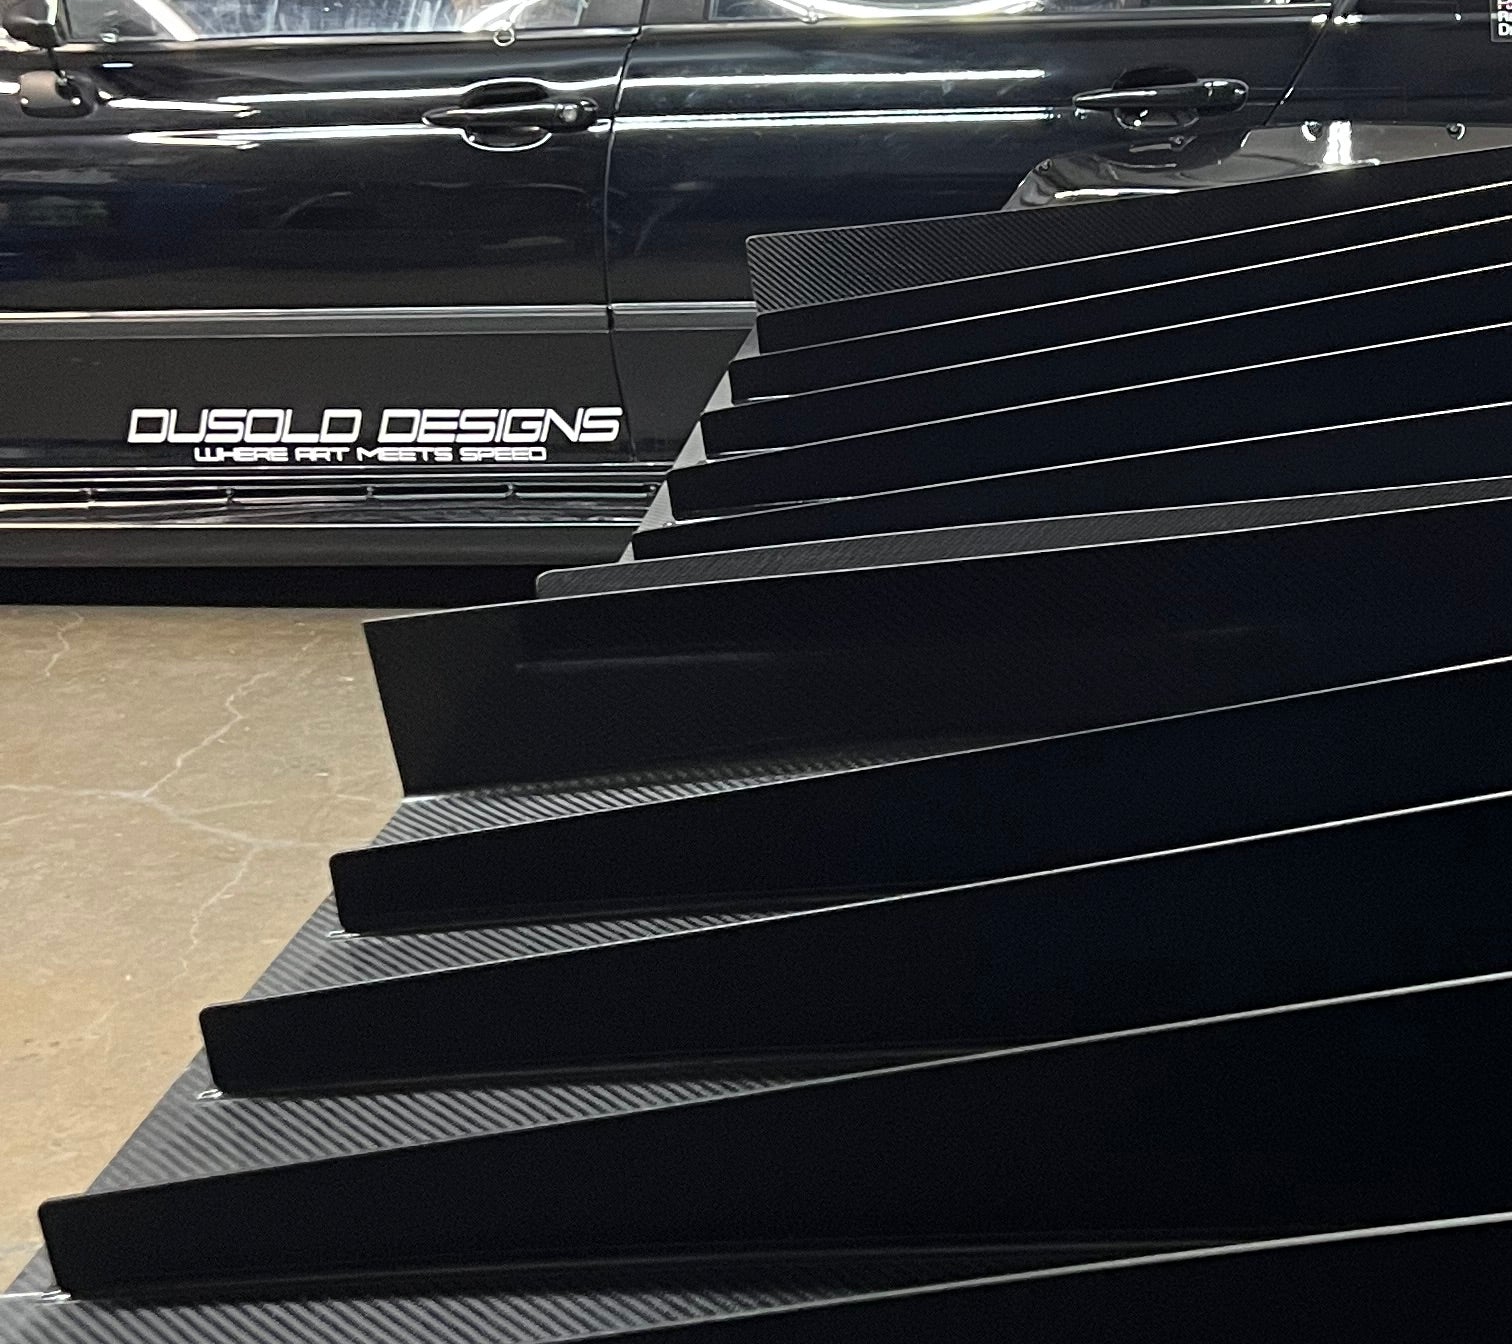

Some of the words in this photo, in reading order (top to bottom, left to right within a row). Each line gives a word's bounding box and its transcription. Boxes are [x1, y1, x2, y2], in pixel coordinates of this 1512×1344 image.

[127, 408, 363, 444] DUSOLD
[378, 406, 623, 443] DESIGNS
[194, 446, 289, 462] WHERE
[294, 446, 350, 462] ART
[356, 446, 453, 462] MEETS
[460, 446, 547, 462] SPEED
